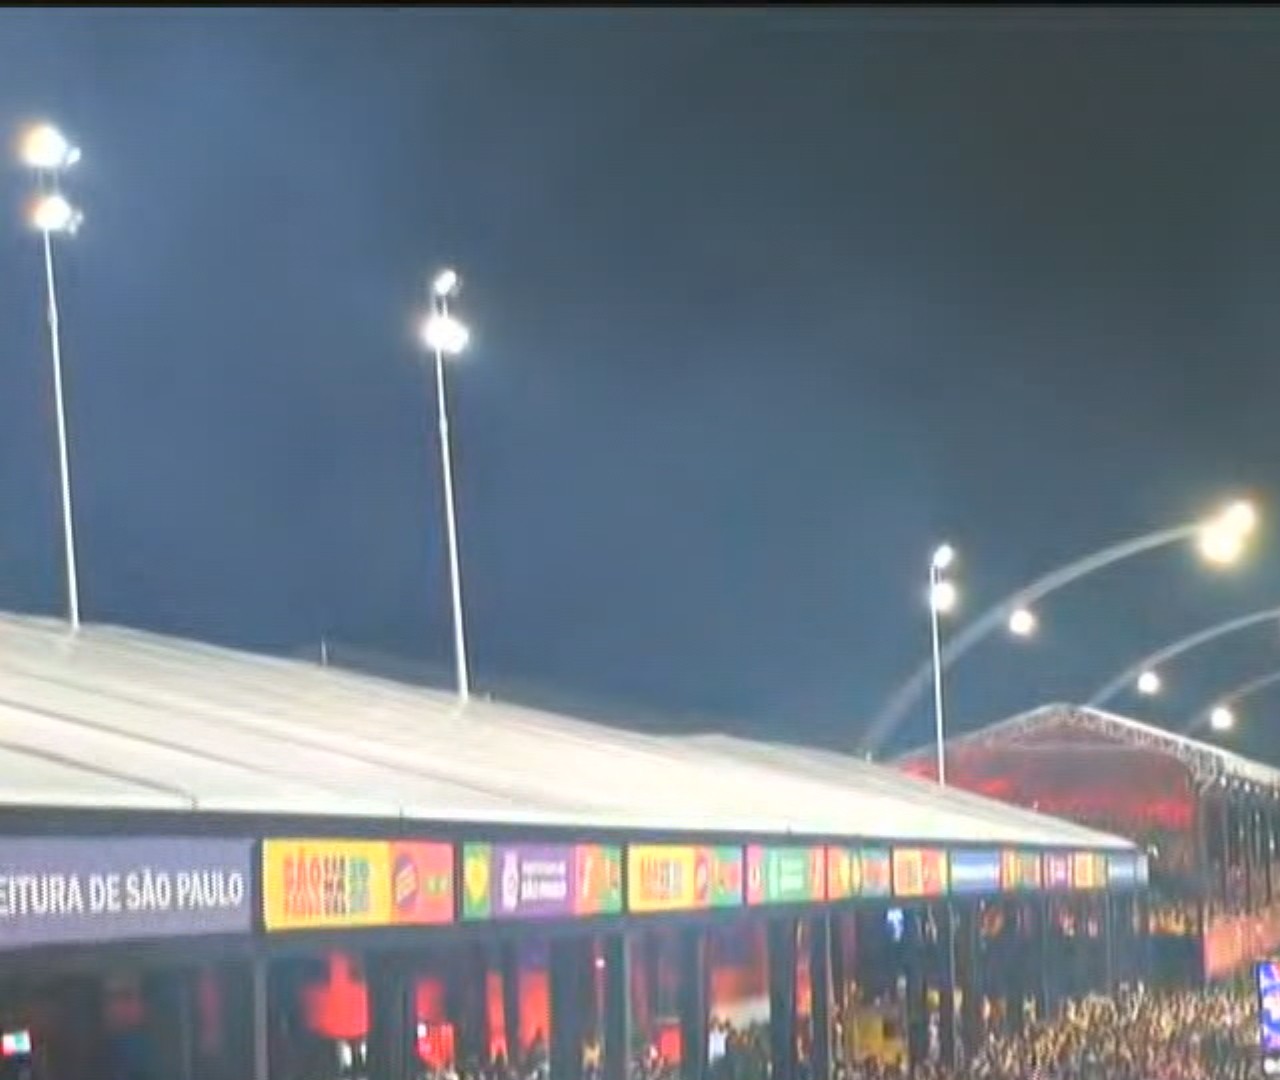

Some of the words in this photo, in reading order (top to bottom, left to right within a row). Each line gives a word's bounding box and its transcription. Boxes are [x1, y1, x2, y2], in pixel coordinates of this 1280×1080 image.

[89, 872, 121, 912] DE
[127, 865, 171, 910] SÃO
[177, 870, 244, 909] PAULO
